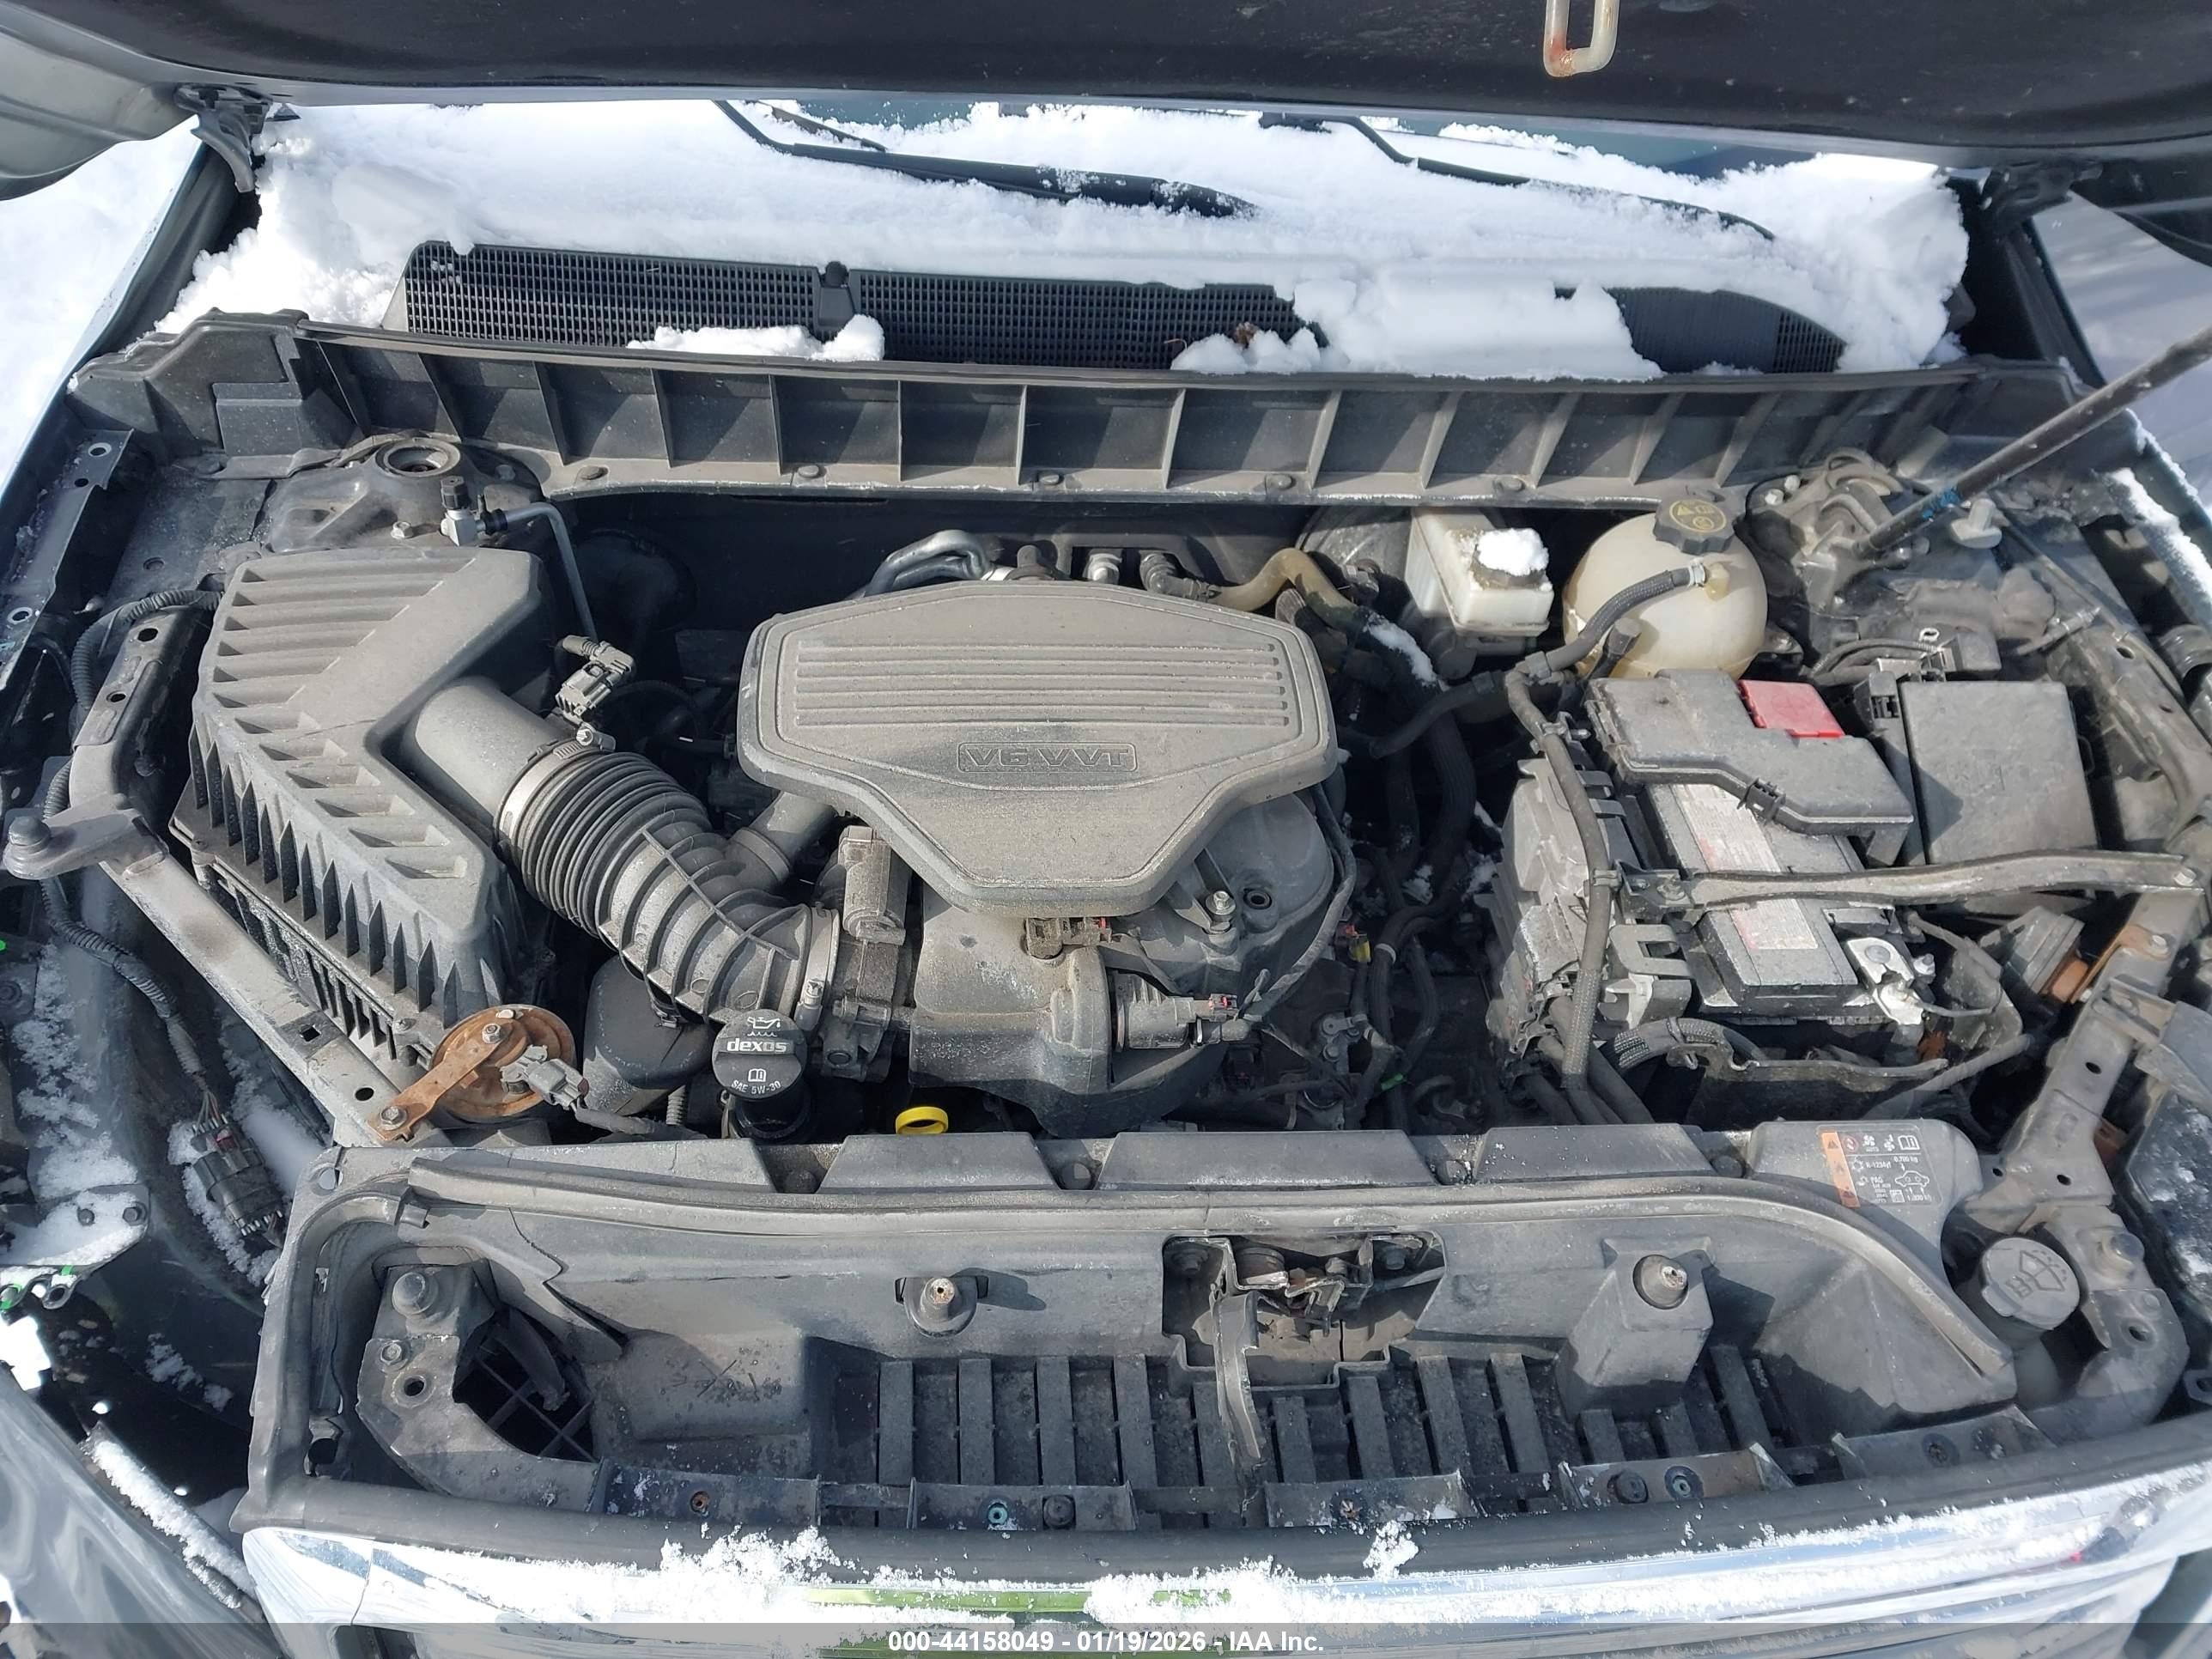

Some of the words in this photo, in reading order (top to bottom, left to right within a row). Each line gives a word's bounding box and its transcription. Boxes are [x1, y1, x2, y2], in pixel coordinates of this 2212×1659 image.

[964, 748, 1030, 767] V6
[1036, 748, 1129, 767] VVT
[726, 1038, 788, 1053] dexos
[731, 1079, 748, 1093] SAE
[751, 1080, 781, 1095] 5W-30
